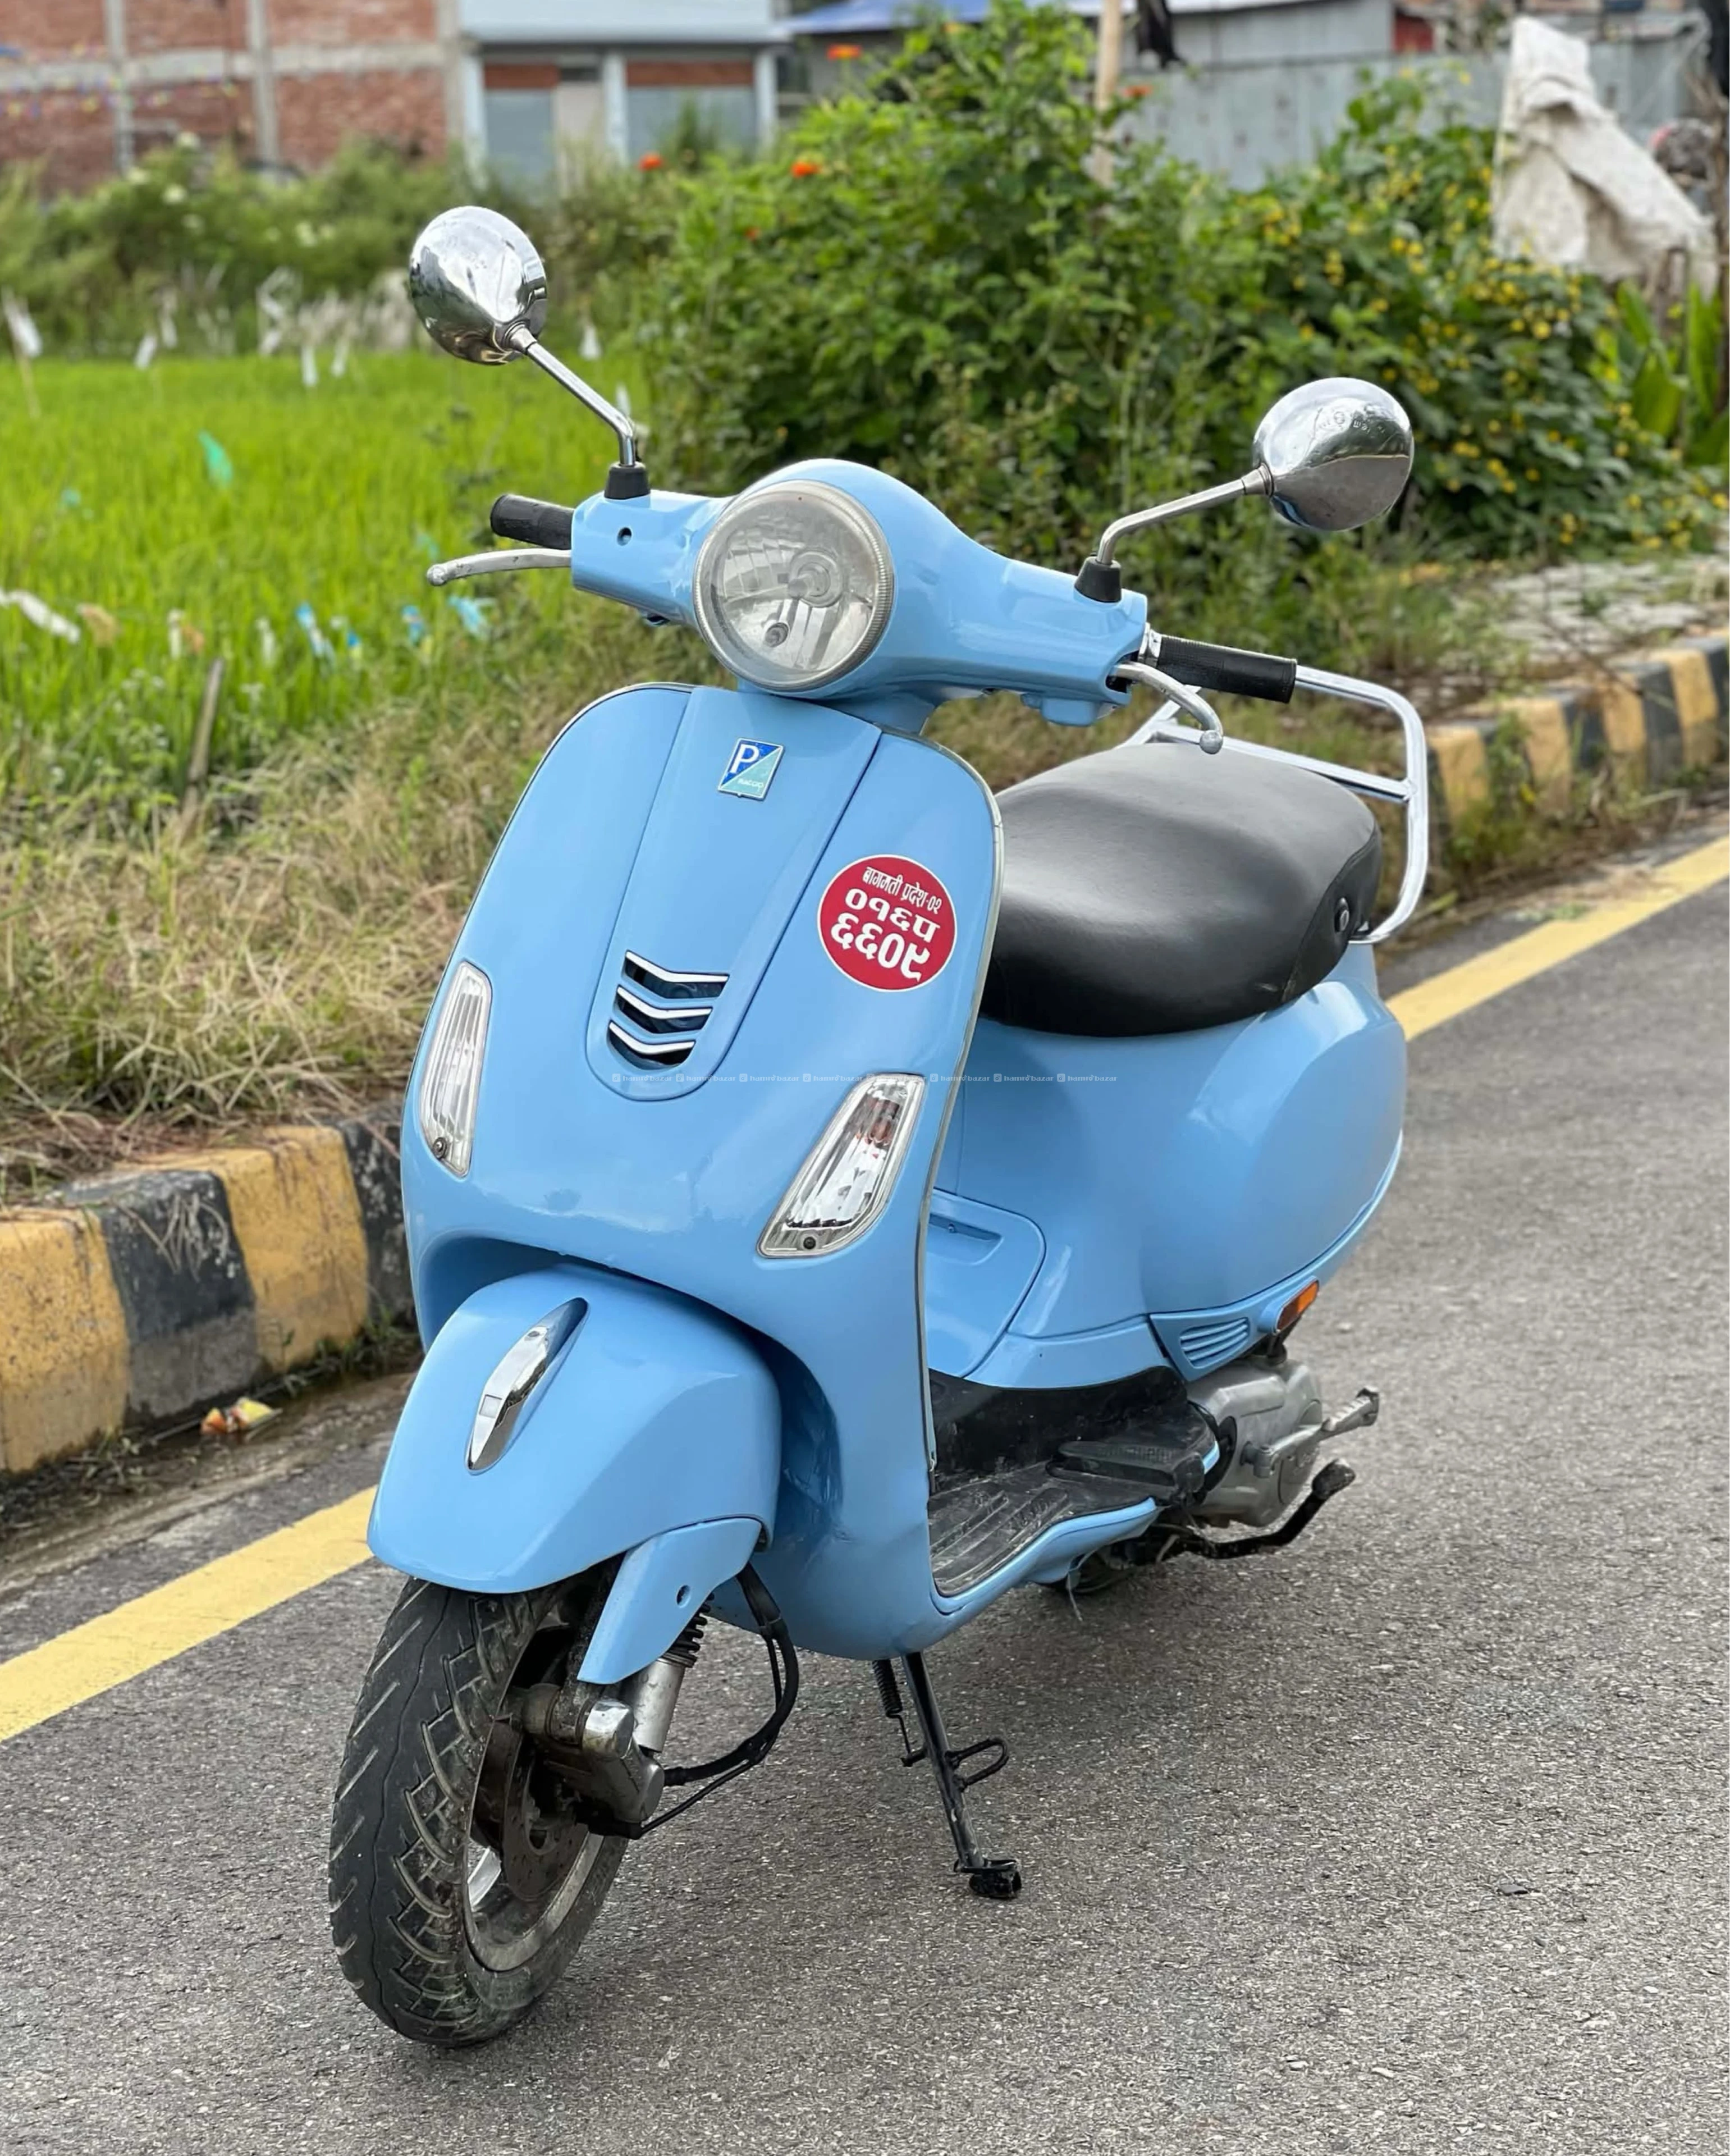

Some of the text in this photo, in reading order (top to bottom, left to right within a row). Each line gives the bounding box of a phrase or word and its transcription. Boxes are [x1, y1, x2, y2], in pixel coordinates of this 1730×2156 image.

[730, 744, 759, 773] P
[862, 866, 903, 896] बागमती
[845, 888, 940, 943] ०१६प
[831, 912, 930, 981] ६६०५
